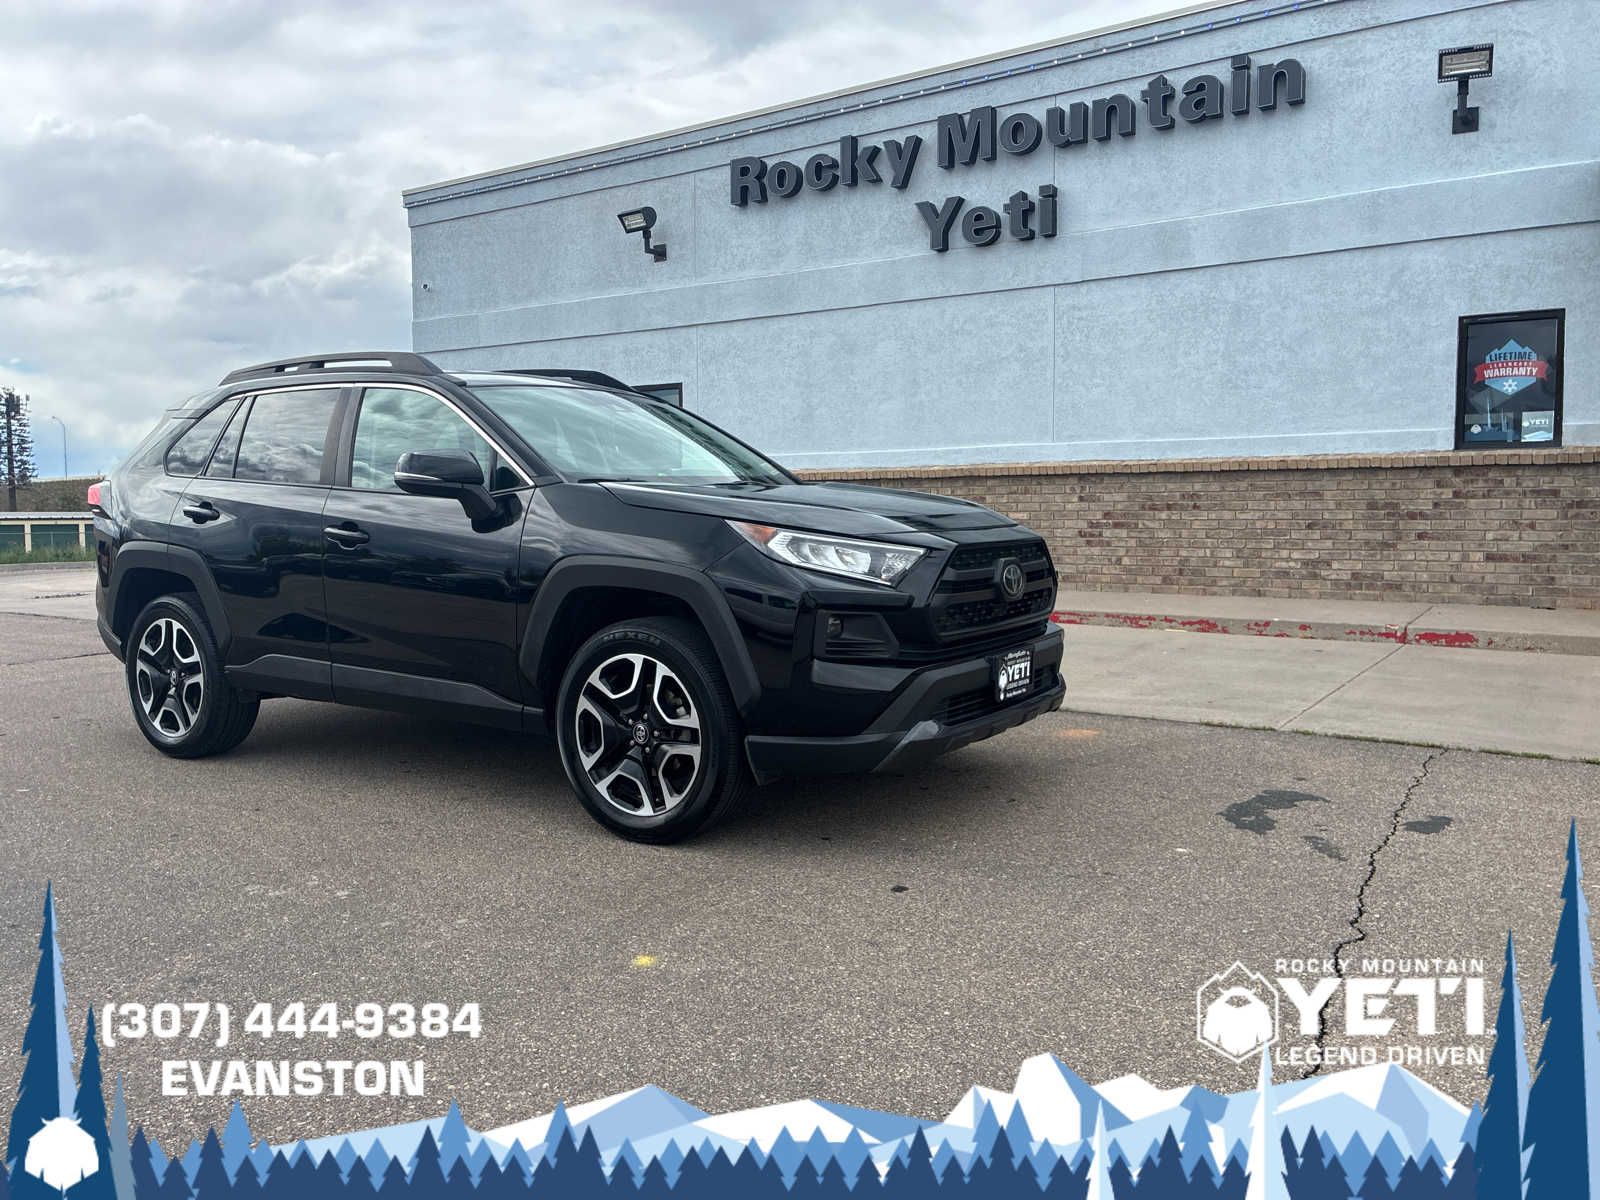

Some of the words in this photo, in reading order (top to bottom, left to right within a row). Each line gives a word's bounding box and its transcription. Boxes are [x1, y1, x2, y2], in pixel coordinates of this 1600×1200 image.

[728, 134, 923, 207] Rocky
[936, 53, 1307, 169] Mountain
[915, 184, 1058, 252] Yeti
[1489, 351, 1533, 361] LIFETIME
[1484, 367, 1538, 378] WARRANTY
[603, 631, 661, 646] NEXEN
[1007, 661, 1031, 682] YETI
